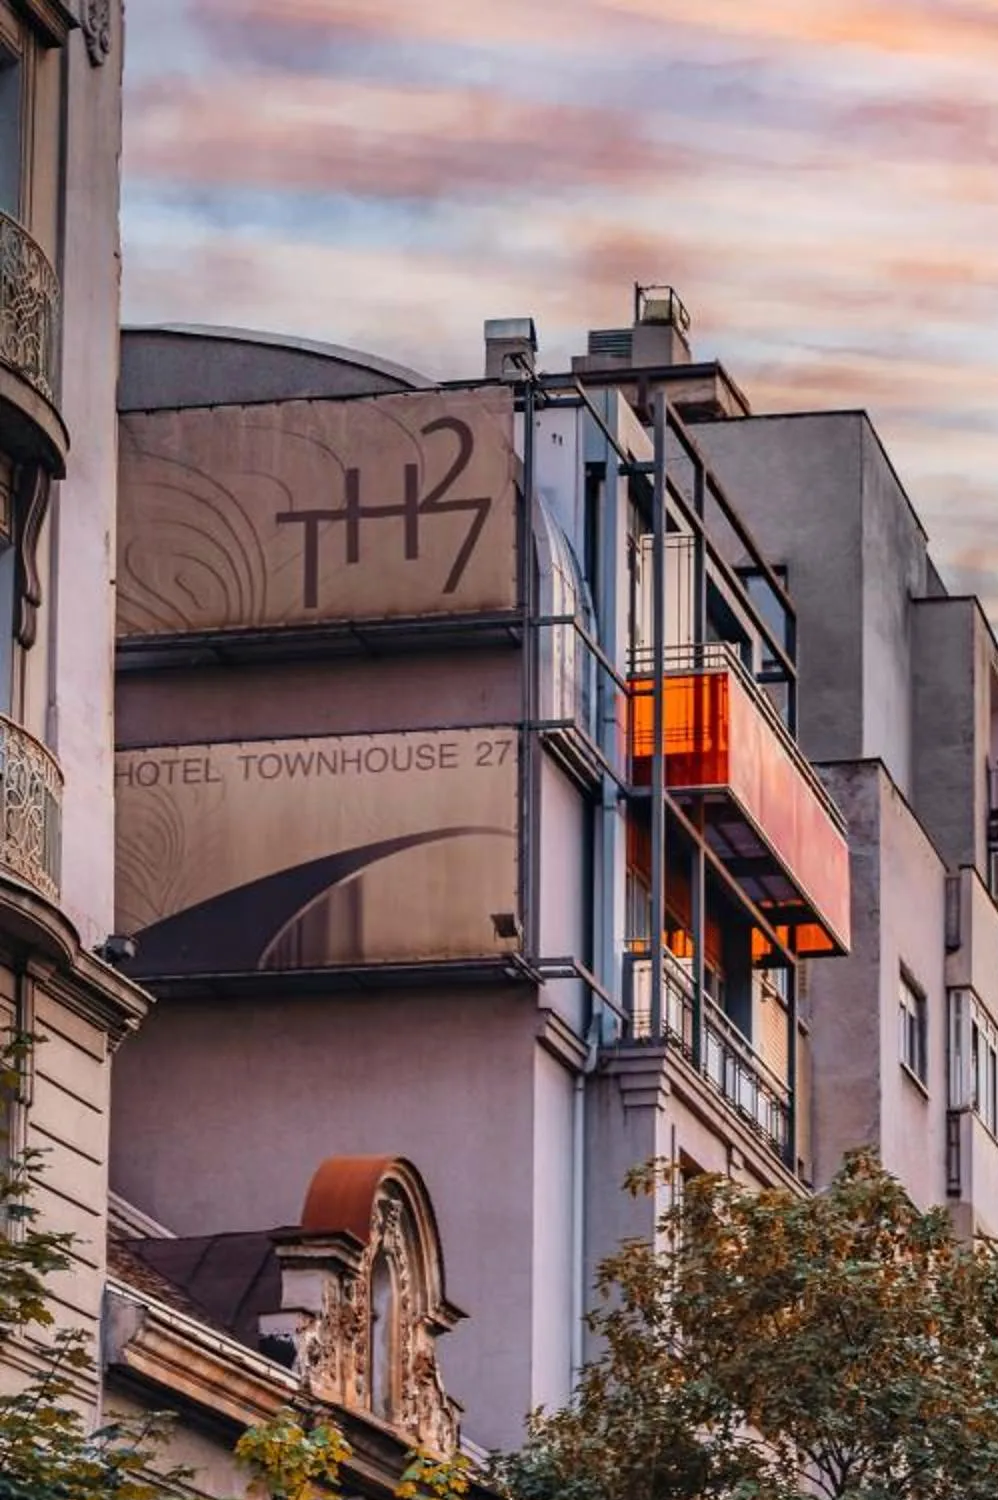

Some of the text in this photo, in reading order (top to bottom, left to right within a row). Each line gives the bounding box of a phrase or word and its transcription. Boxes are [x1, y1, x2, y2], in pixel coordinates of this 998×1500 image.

[114, 740, 513, 788] HOTEL TOWNHOUSE 27
